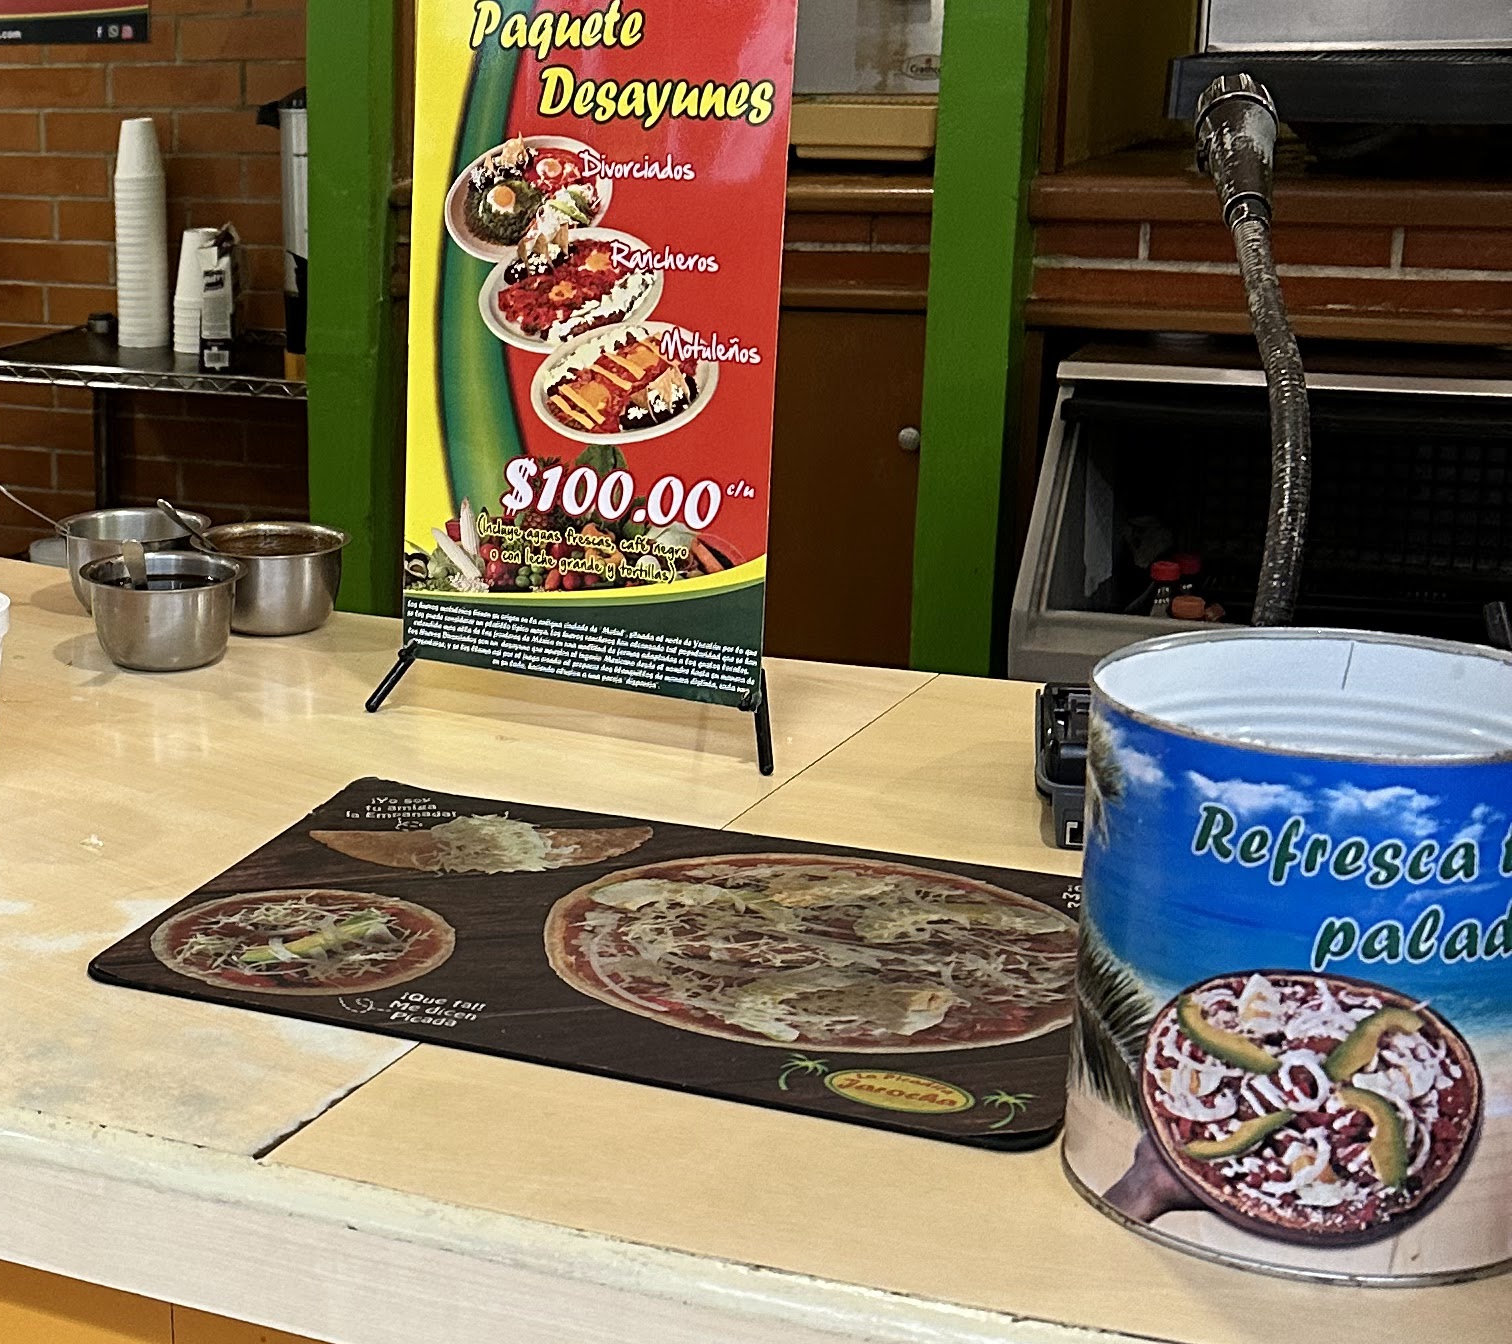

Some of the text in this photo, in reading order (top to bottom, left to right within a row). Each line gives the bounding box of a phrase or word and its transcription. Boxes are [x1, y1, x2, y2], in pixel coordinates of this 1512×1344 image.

[538, 66, 776, 129] Desayunes
[579, 152, 695, 182] Divorciados
[609, 241, 719, 273] Rancheros
[659, 327, 762, 364] Motuleños
[502, 455, 755, 529] $100.00 c/u
[501, 551, 521, 564] con
[525, 550, 556, 569] leche
[560, 557, 603, 576] grande
[607, 562, 616, 580] y
[1194, 804, 1476, 889] Refresca
[389, 1000, 477, 1021] Me dicen
[389, 1011, 457, 1027] Picada
[838, 1078, 958, 1107] Jarocha
